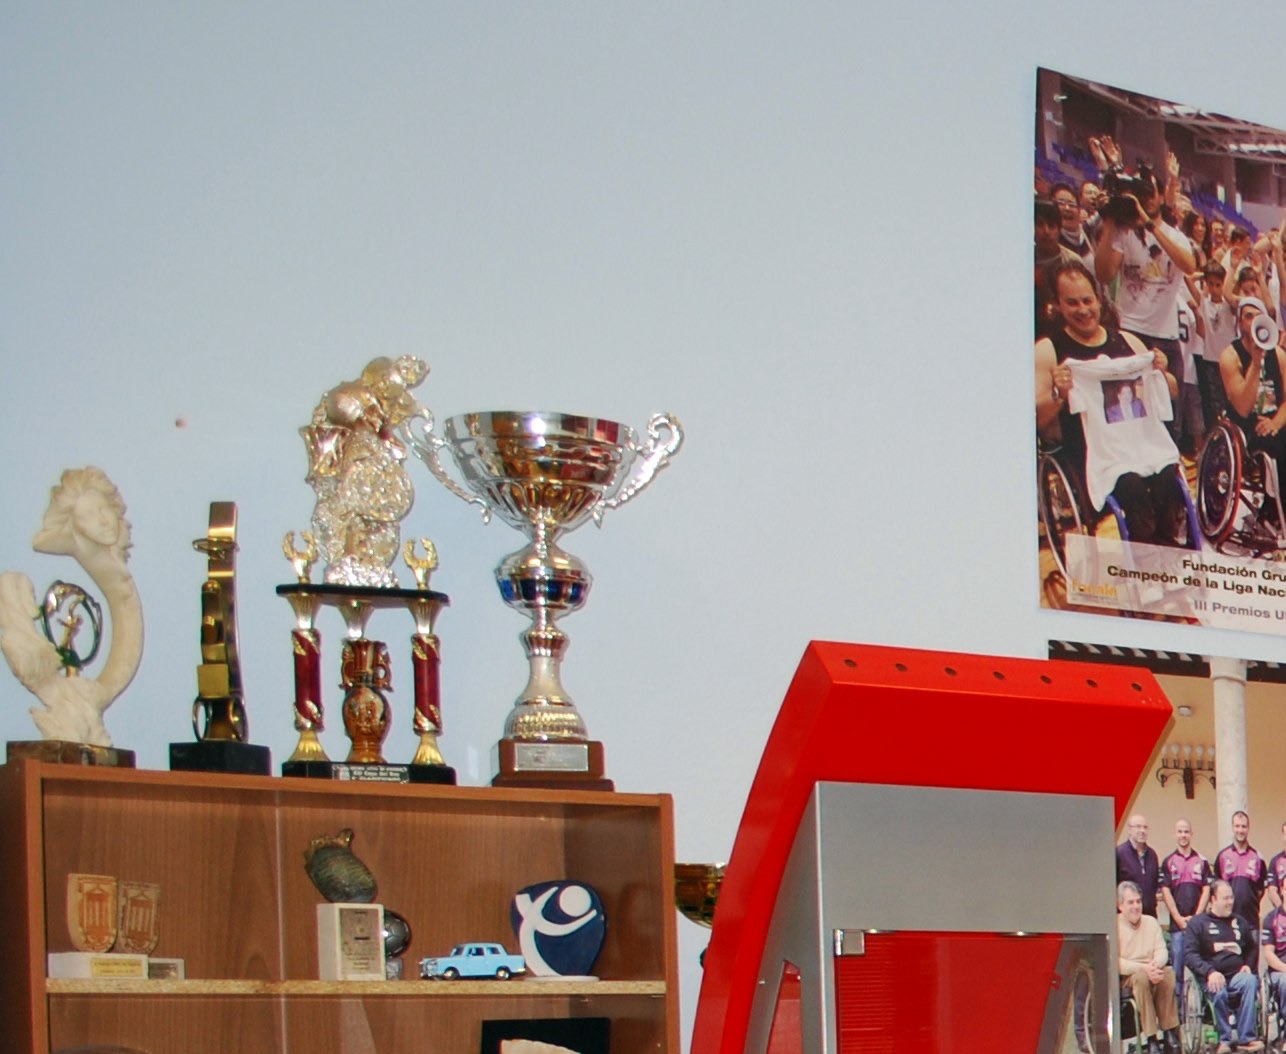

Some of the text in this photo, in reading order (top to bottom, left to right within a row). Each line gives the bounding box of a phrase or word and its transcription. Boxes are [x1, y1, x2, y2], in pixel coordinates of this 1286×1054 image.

[1182, 559, 1257, 579] Fundación
[1107, 565, 1178, 585] Campeón
[1183, 575, 1201, 587] de
[1205, 578, 1218, 589] la
[1223, 580, 1253, 594] Liga
[1194, 600, 1207, 611] III
[1212, 602, 1271, 619] Premios
